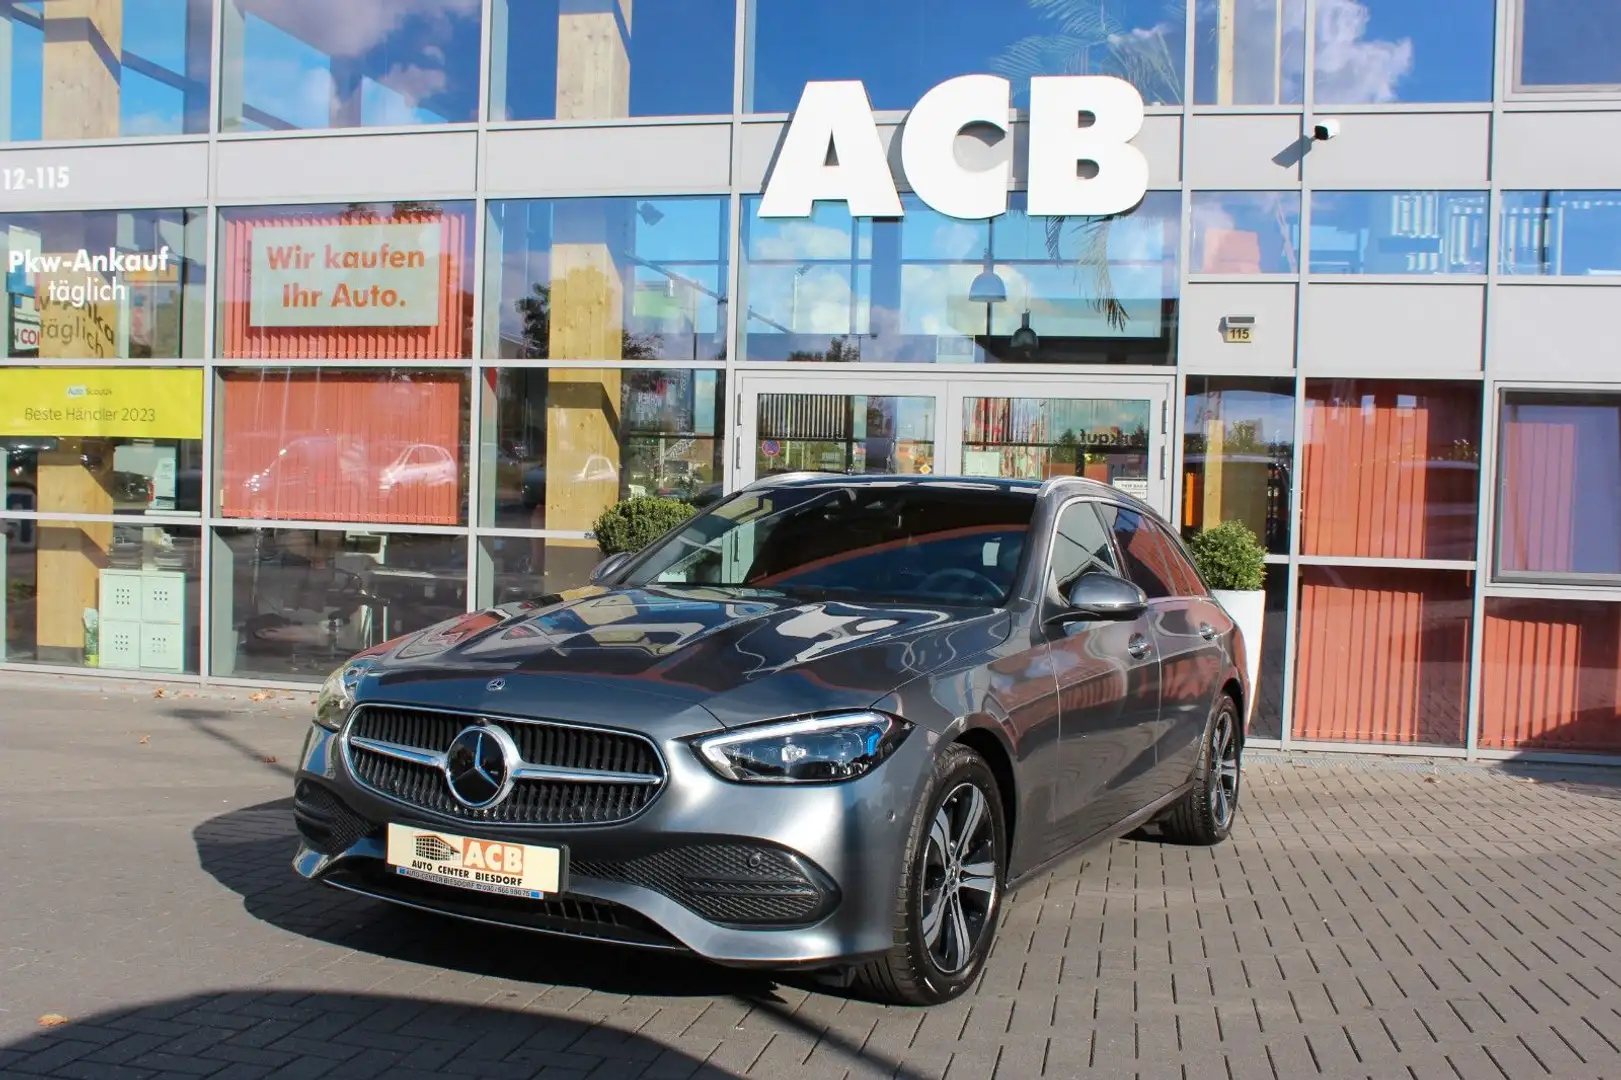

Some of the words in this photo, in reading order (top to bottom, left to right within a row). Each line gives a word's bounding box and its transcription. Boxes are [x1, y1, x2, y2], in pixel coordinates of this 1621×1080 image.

[757, 74, 1149, 220] ACB
[8, 246, 168, 273] Pkw-Ankauf
[266, 245, 314, 269] Wir
[325, 243, 424, 268] kaufen
[48, 277, 126, 307] täglich
[282, 282, 322, 307] Ihr
[330, 283, 406, 307] Auto.
[1230, 328, 1250, 339] 115
[24, 407, 62, 421] Beste
[66, 406, 117, 421] Händler
[121, 407, 156, 422] 2023
[463, 841, 522, 873] ACB
[412, 860, 433, 872] AUTO
[438, 865, 469, 879] CENTER
[475, 872, 523, 887] BIESDORF
